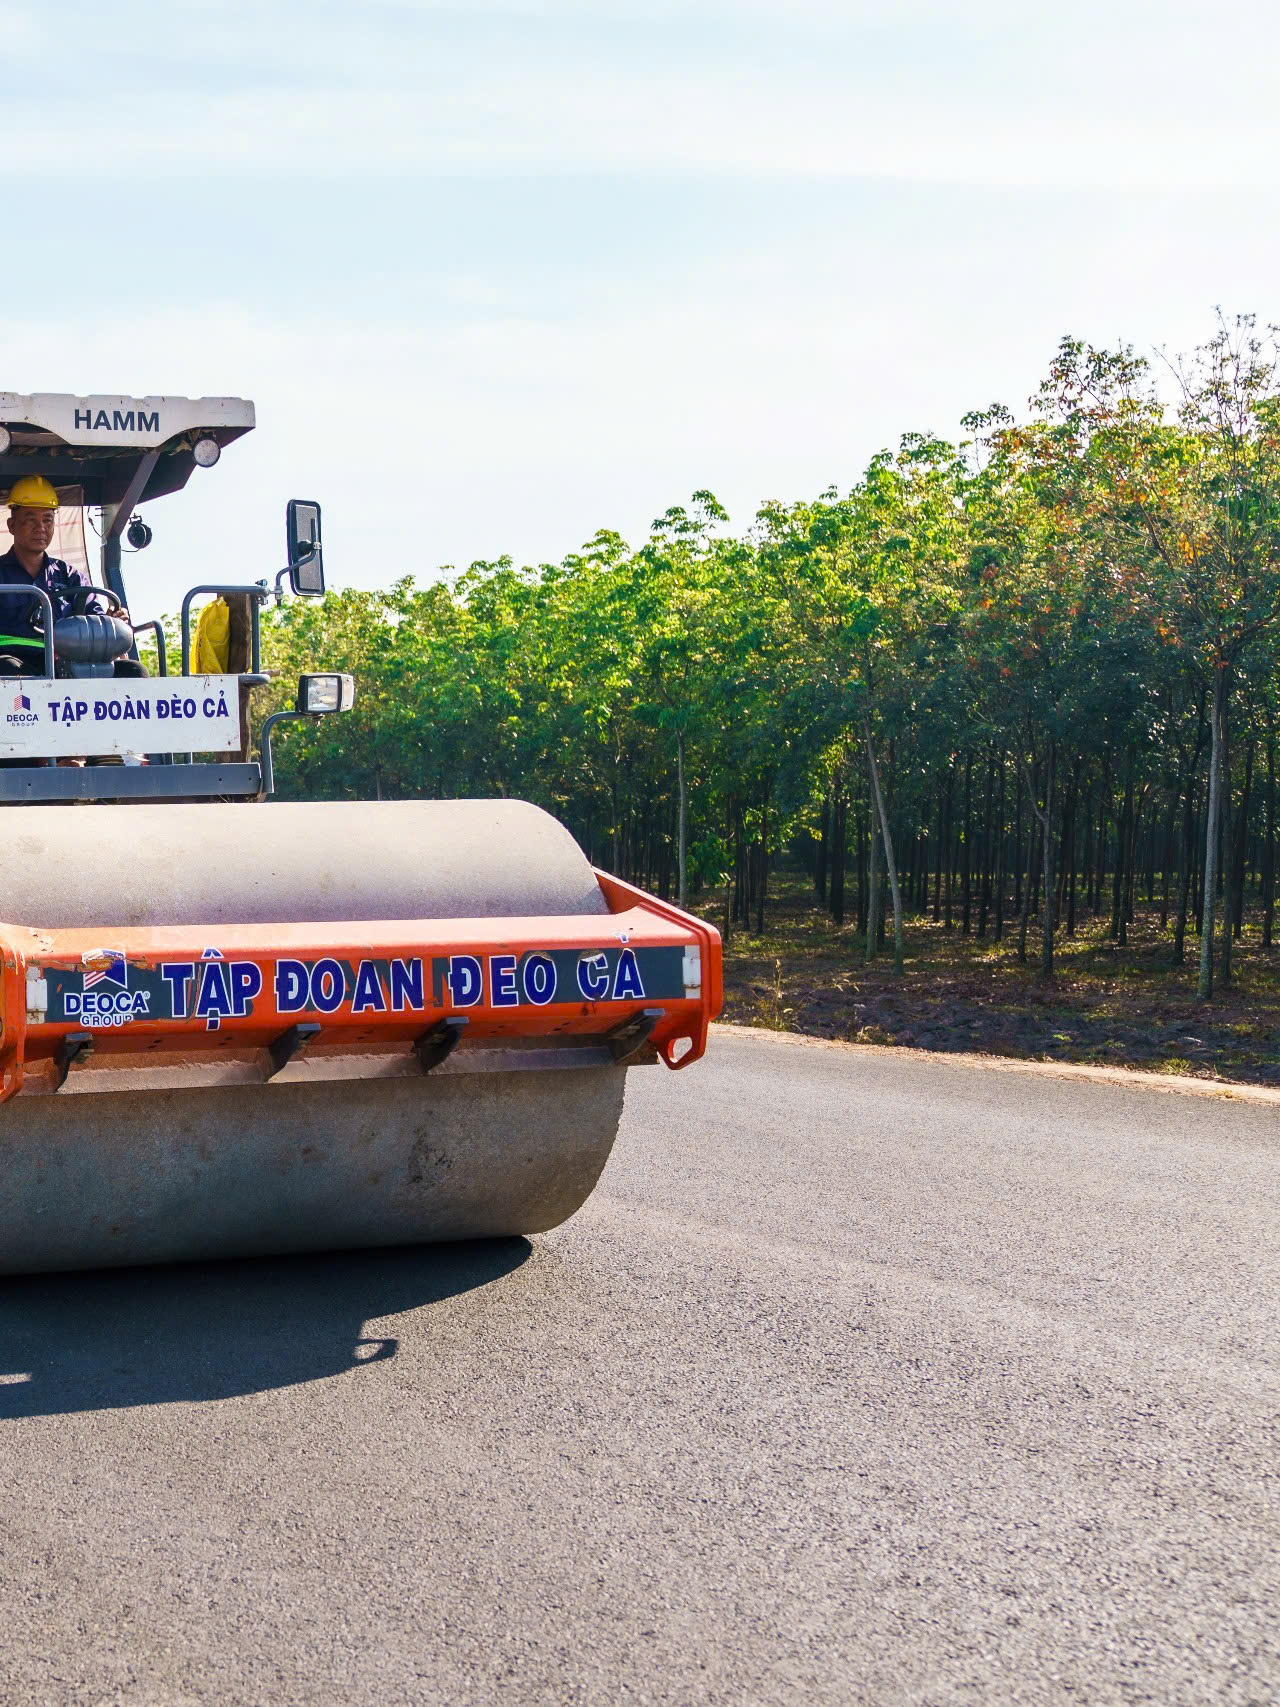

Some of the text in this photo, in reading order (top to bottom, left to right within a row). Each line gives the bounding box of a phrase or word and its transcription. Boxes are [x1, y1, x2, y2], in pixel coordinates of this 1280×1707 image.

[74, 408, 160, 432] HAMM
[6, 714, 39, 722] DEOCA
[47, 690, 229, 728] TẬP ĐOÀN ĐÈO CẢ
[161, 947, 263, 1032] TẬP
[64, 991, 150, 1016] DEOCA
[80, 1014, 134, 1028] GROUP
